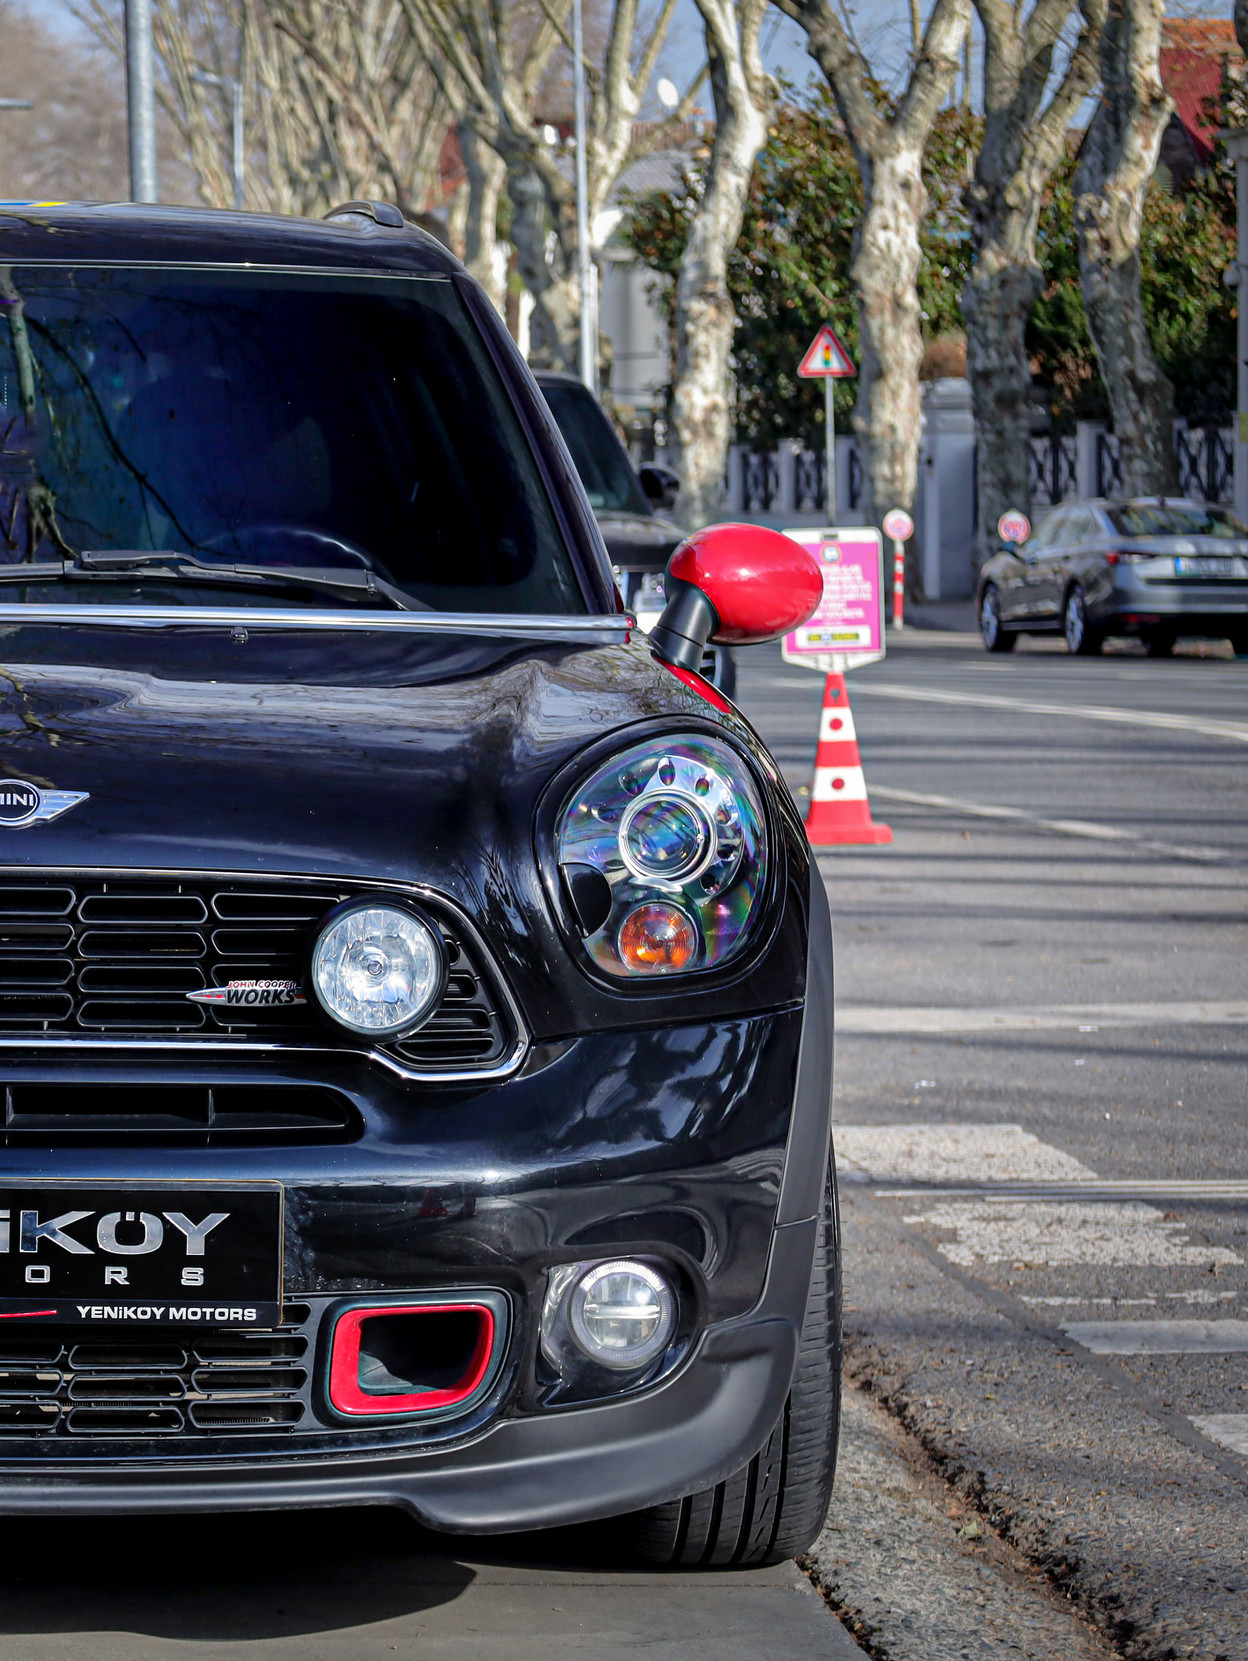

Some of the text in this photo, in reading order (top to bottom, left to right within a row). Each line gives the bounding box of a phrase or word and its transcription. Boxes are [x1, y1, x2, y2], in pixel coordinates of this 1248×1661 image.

[227, 981, 254, 989] JOHN
[227, 989, 296, 1004] WORKS
[168, 1307, 257, 1321] MOTORS
